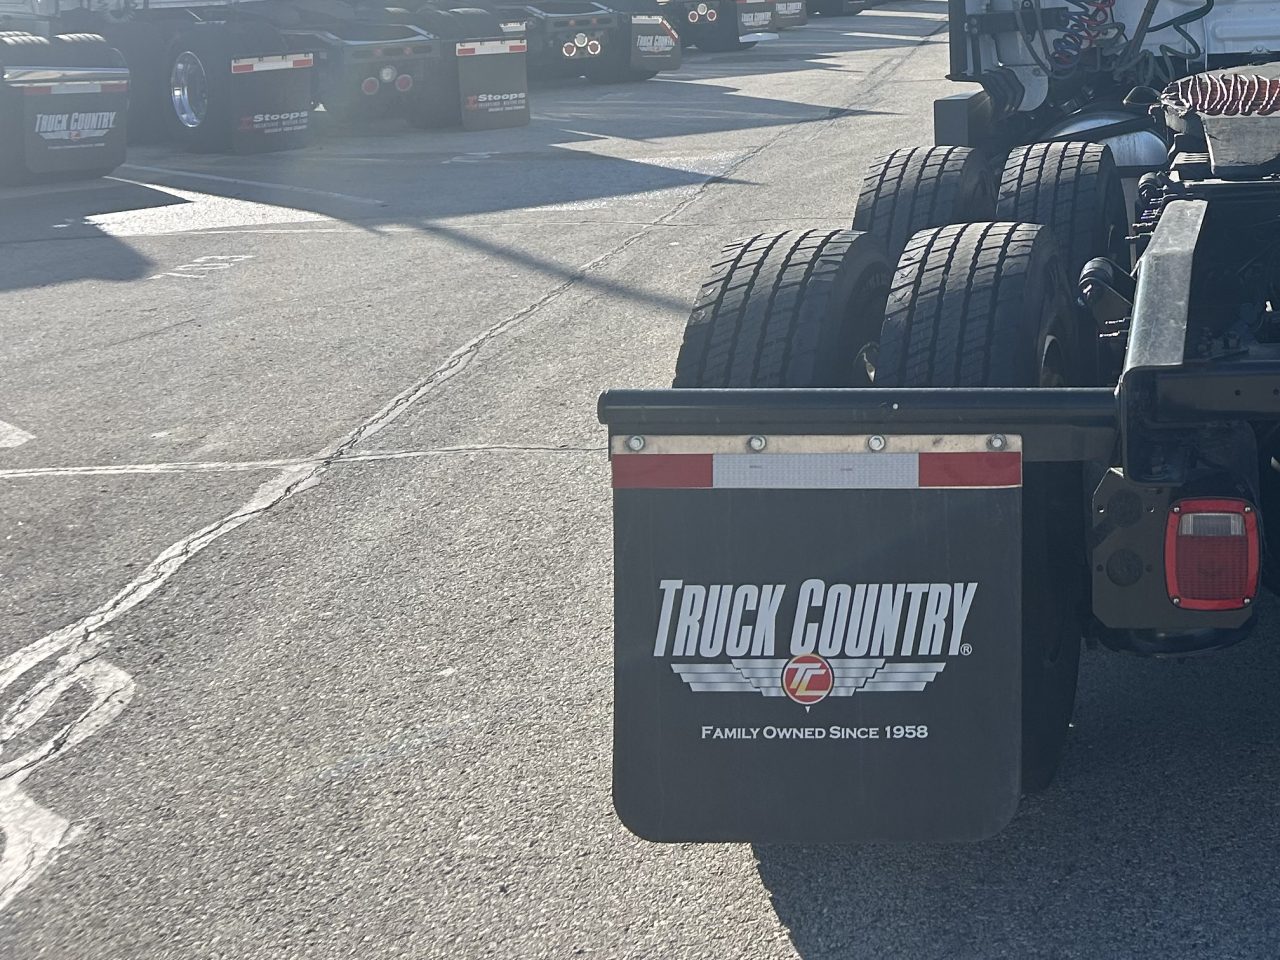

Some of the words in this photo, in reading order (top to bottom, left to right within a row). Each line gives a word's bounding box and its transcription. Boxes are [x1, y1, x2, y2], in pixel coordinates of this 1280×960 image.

[478, 93, 526, 102] Stoops
[35, 114, 69, 132] TRUCK
[70, 111, 117, 130] COUNTRY
[253, 111, 308, 122] Stoops
[653, 579, 786, 657] TRUCK
[701, 725, 760, 740] FAMILY
[763, 725, 826, 740] OWNED
[829, 725, 879, 740] SINCE
[884, 725, 929, 739] 1958
